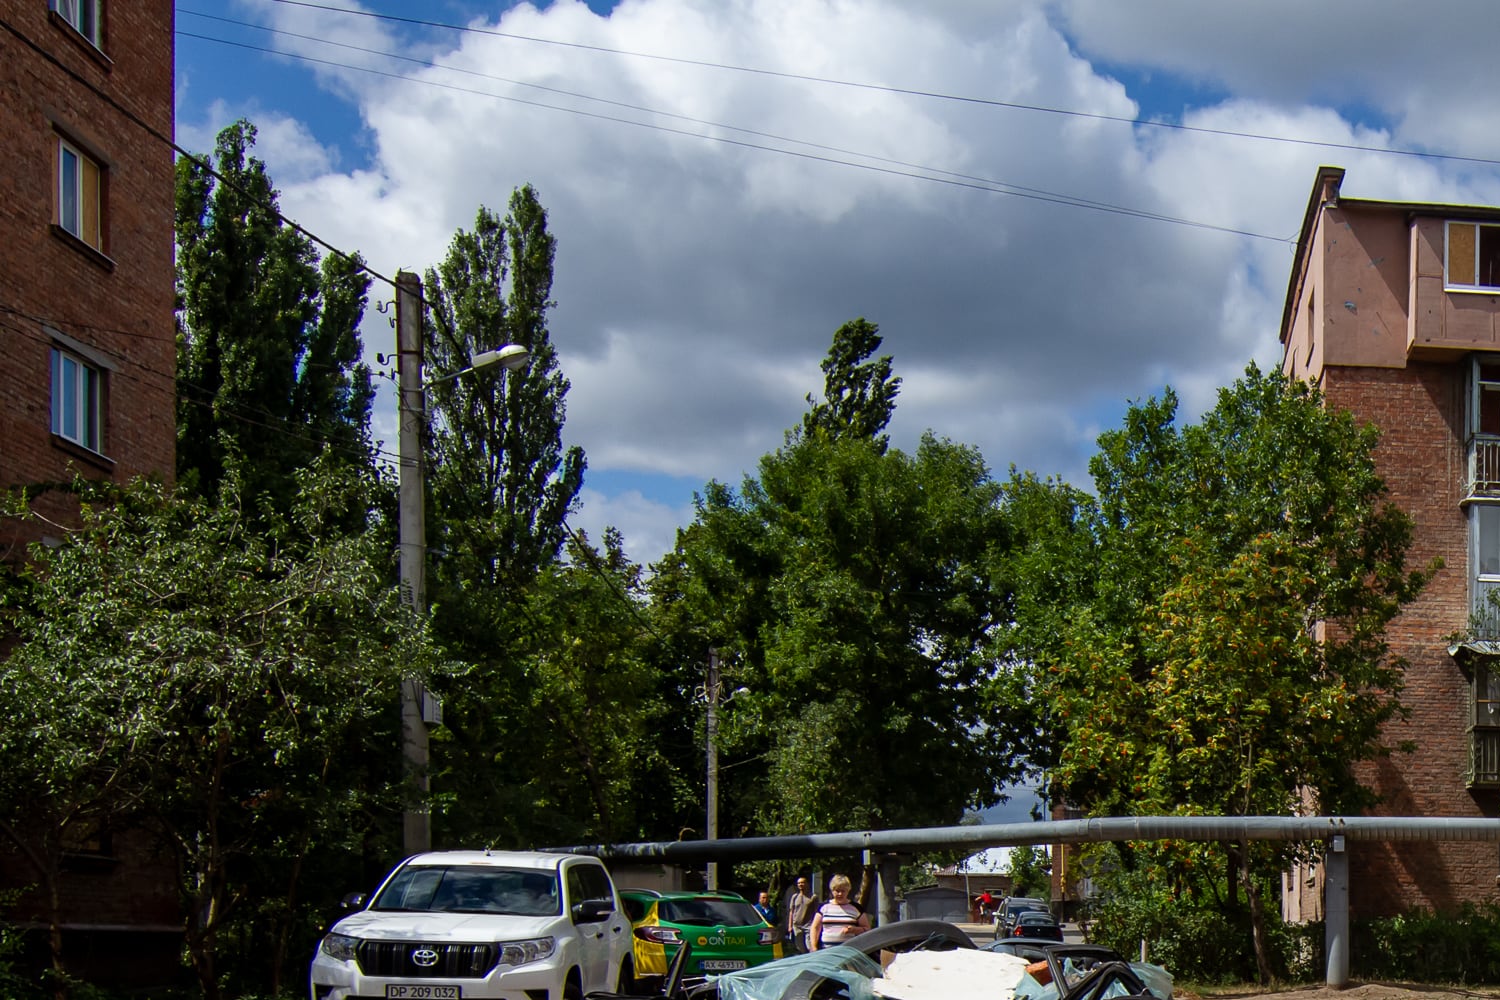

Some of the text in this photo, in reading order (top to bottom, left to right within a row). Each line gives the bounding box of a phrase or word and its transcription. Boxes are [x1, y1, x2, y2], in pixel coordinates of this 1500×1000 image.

[390, 986, 456, 998] DP 209 032
